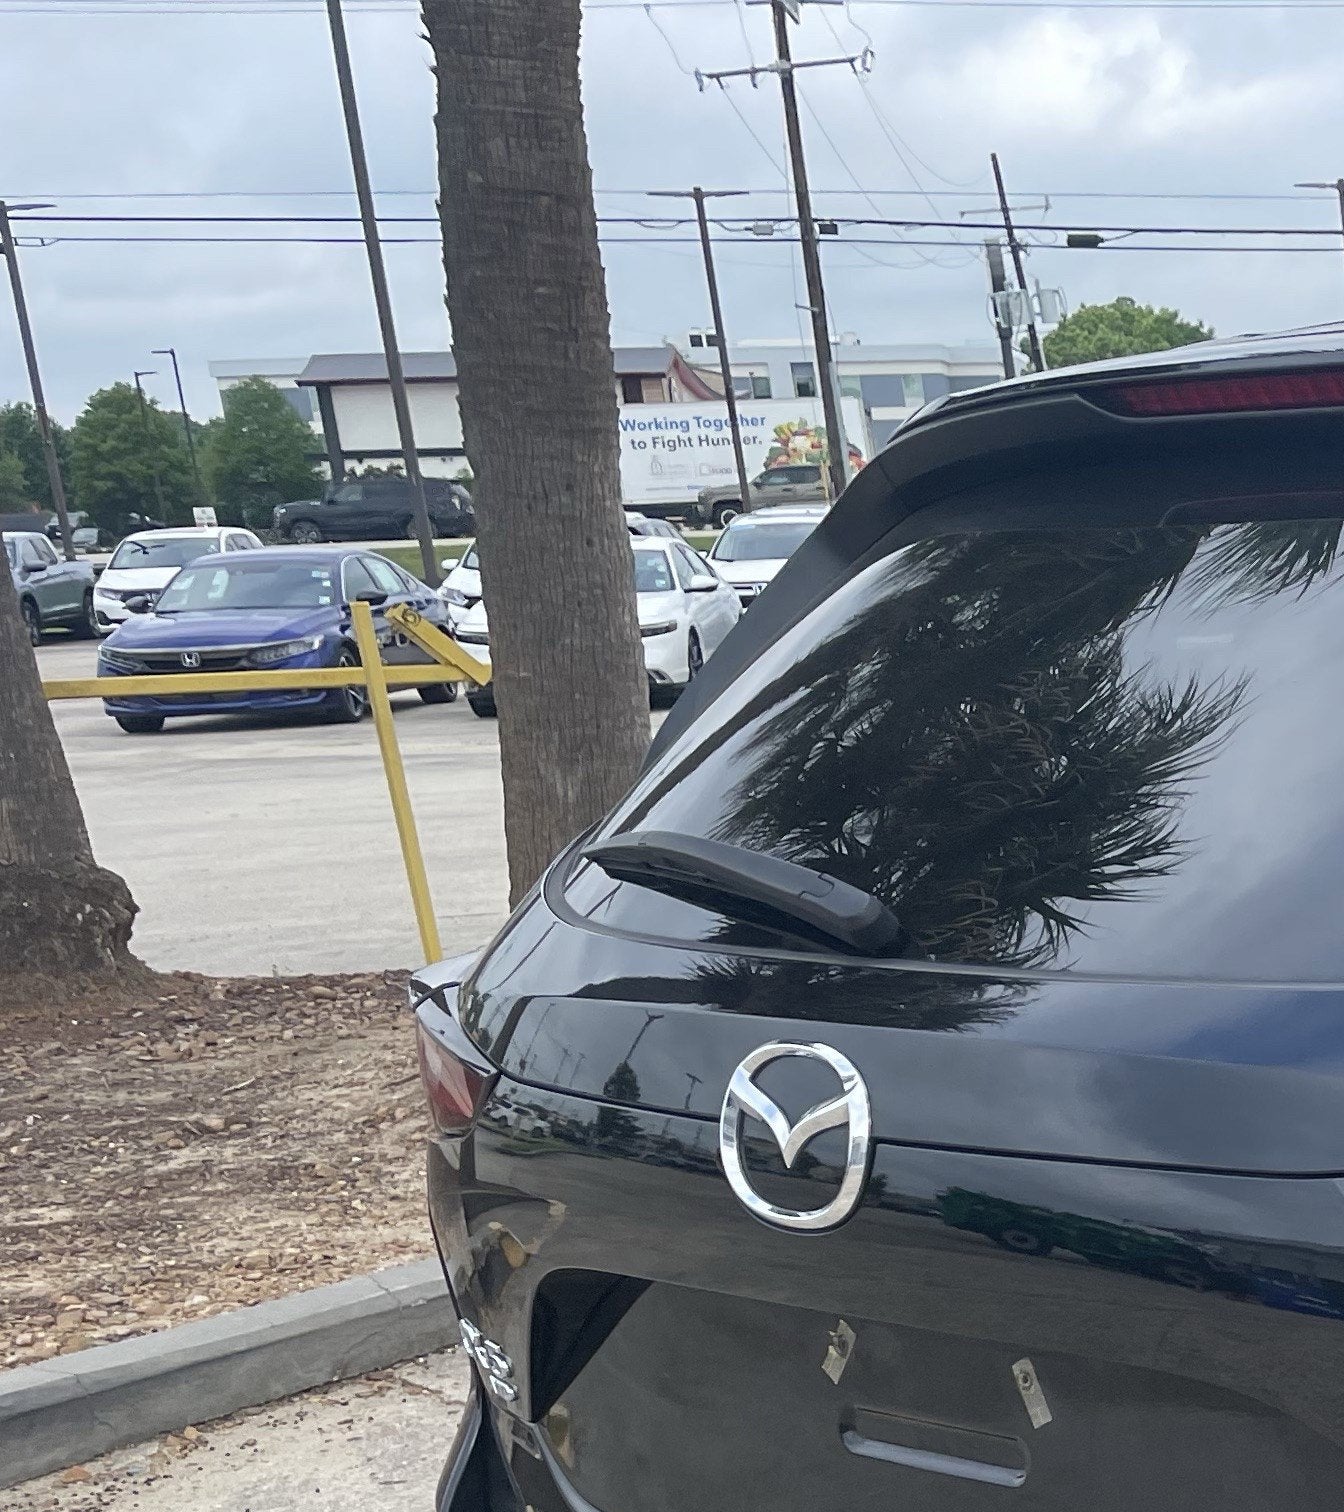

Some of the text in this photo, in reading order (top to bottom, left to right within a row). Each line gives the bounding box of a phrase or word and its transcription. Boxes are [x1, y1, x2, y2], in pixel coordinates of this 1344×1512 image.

[619, 416, 690, 433] Working
[630, 434, 763, 452] to Fight Huner.
